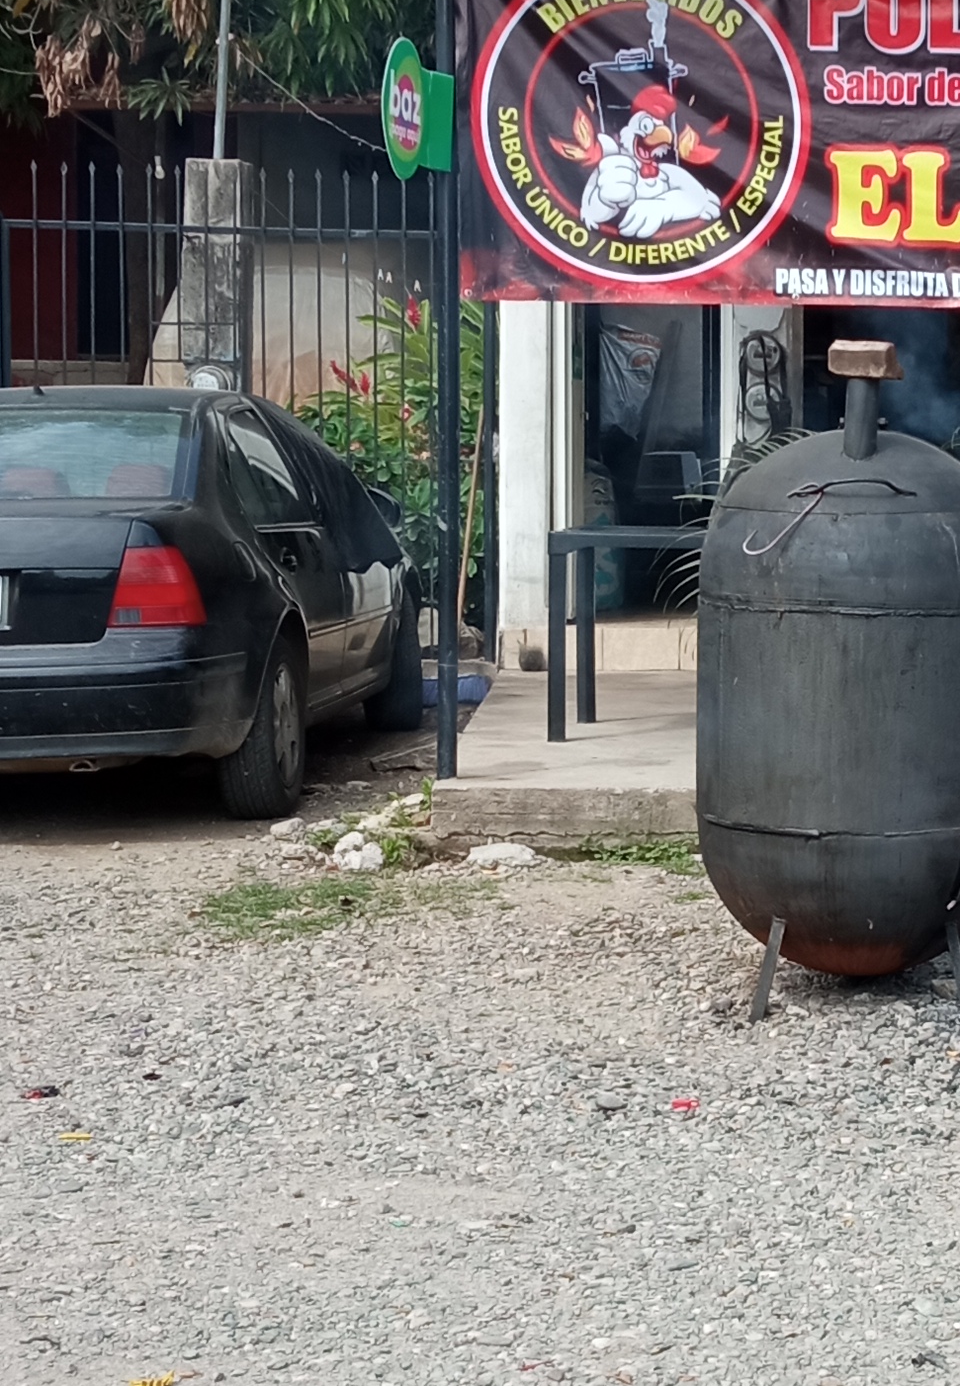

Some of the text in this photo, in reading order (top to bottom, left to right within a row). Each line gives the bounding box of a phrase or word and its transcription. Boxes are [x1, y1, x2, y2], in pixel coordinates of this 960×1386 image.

[389, 69, 421, 125] baz
[824, 65, 921, 104] Sabor
[497, 106, 532, 190] SABOR
[525, 187, 589, 248] ÚNICO
[608, 220, 731, 265] DIFERENTE
[736, 115, 784, 216] ESPECIAL
[775, 268, 829, 295] PASA
[831, 269, 846, 295] Y
[850, 269, 948, 298] DISFRUTA
